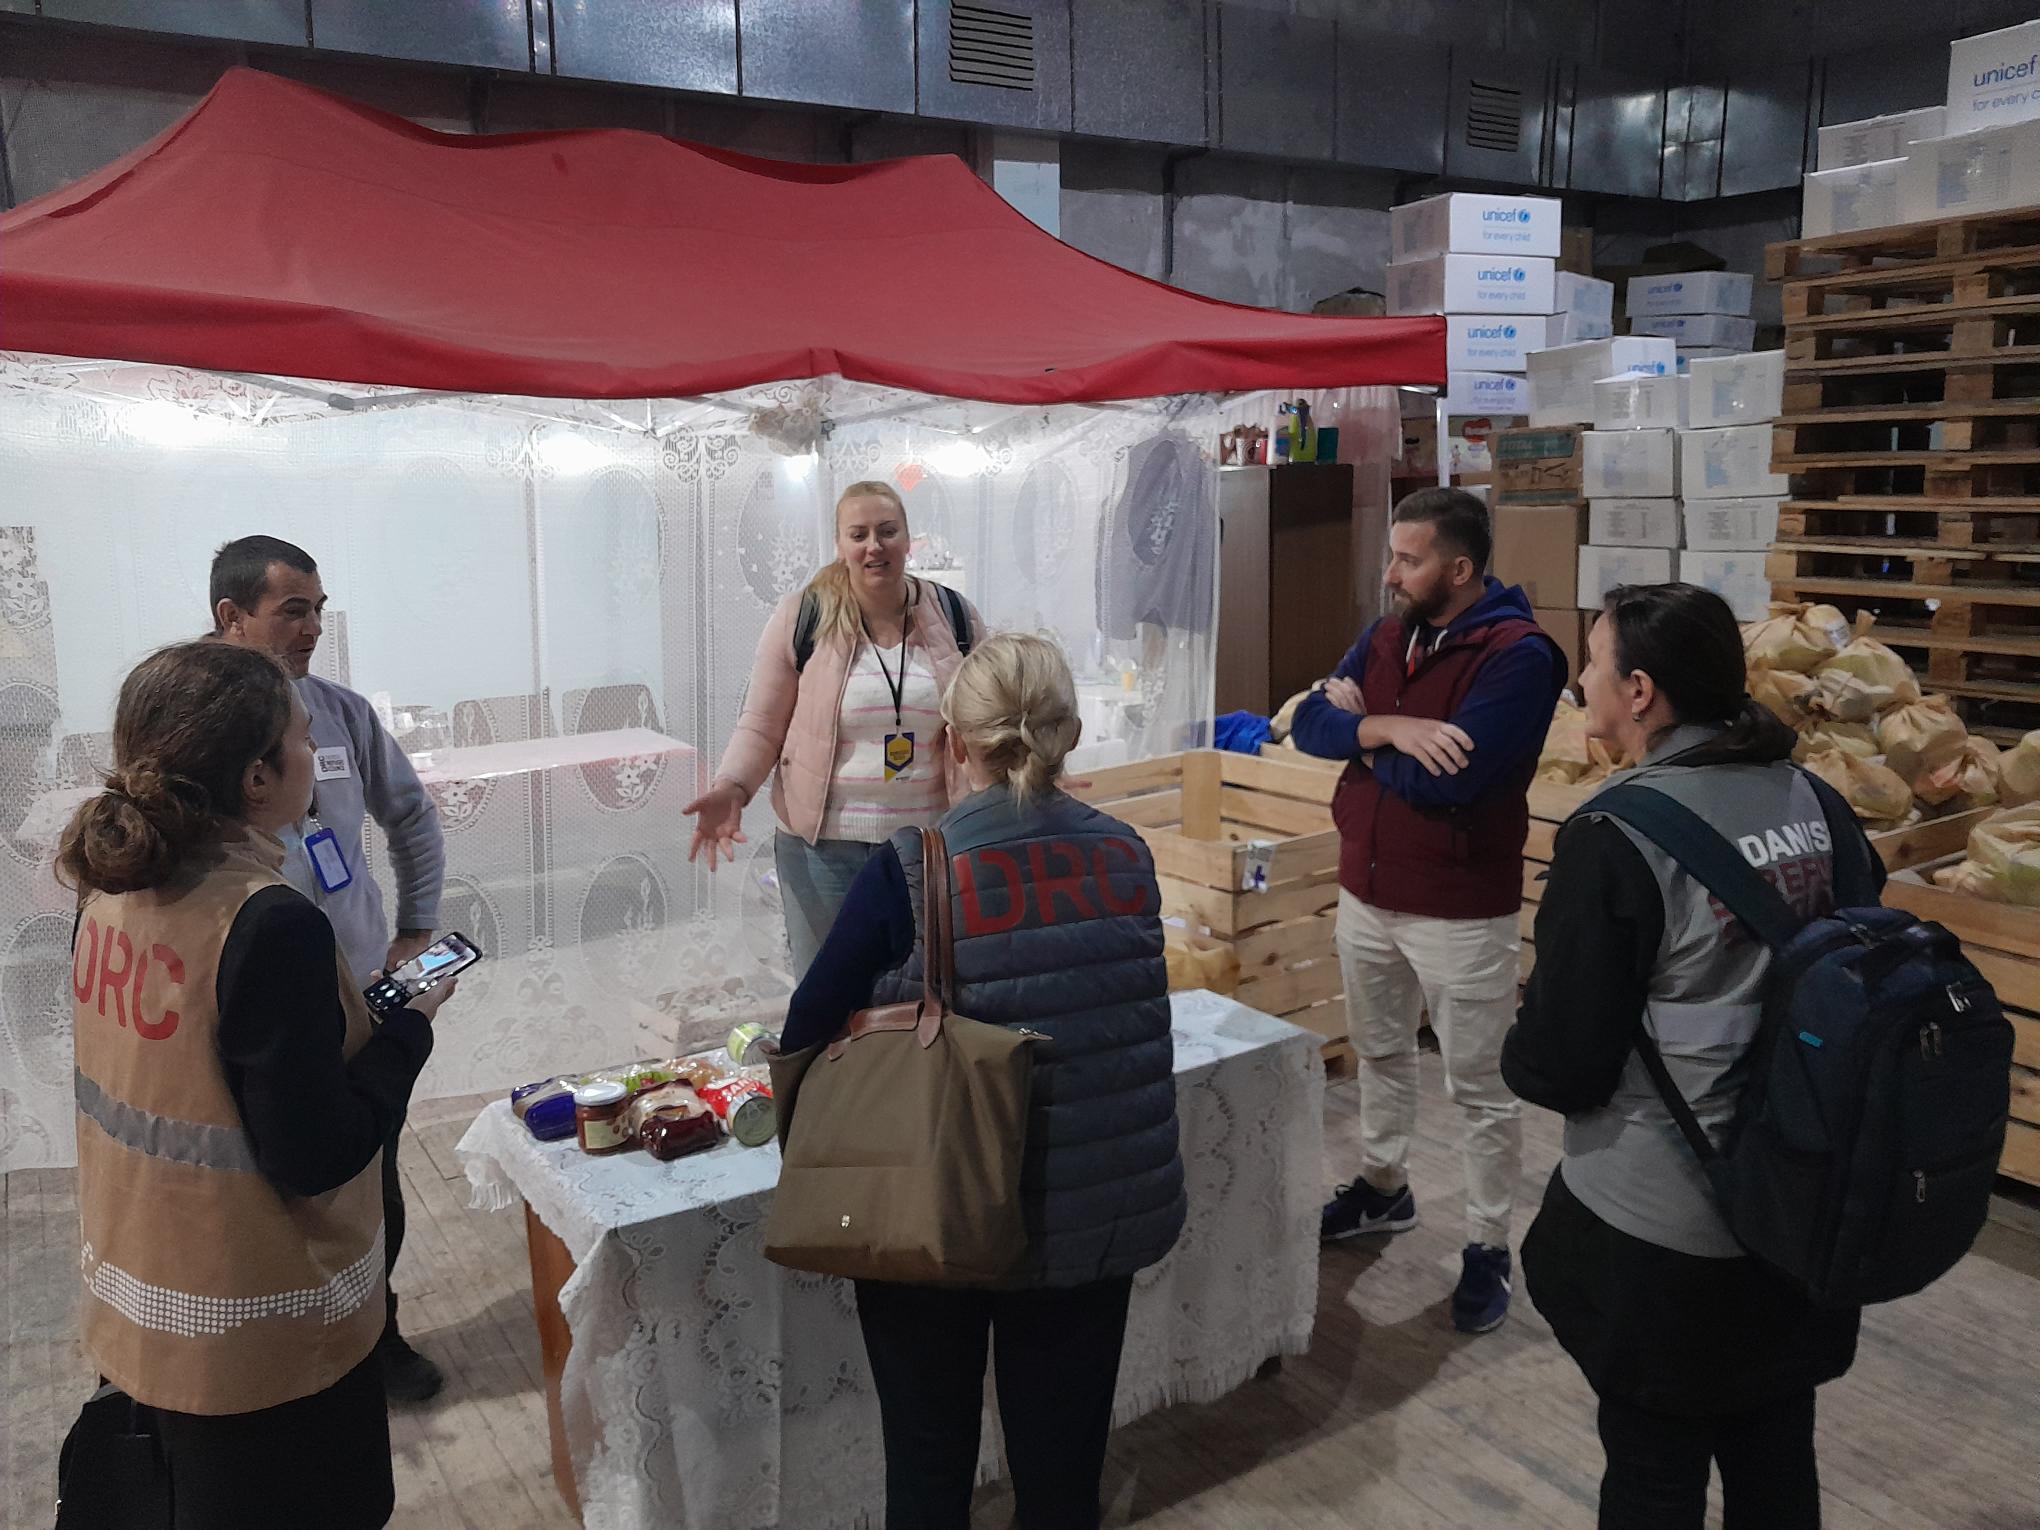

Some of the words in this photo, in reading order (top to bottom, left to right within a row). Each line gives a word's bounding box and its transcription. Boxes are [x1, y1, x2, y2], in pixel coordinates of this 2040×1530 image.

[1973, 54, 2038, 87] unicef
[1972, 99, 1990, 112] for
[1991, 92, 2028, 109] every
[1482, 208, 1516, 223] unicef
[1477, 266, 1512, 281] unicef
[1467, 324, 1503, 339] unicef
[1473, 377, 1505, 391] unicef
[952, 838, 1147, 938] DRC
[73, 916, 186, 1041] DRC
